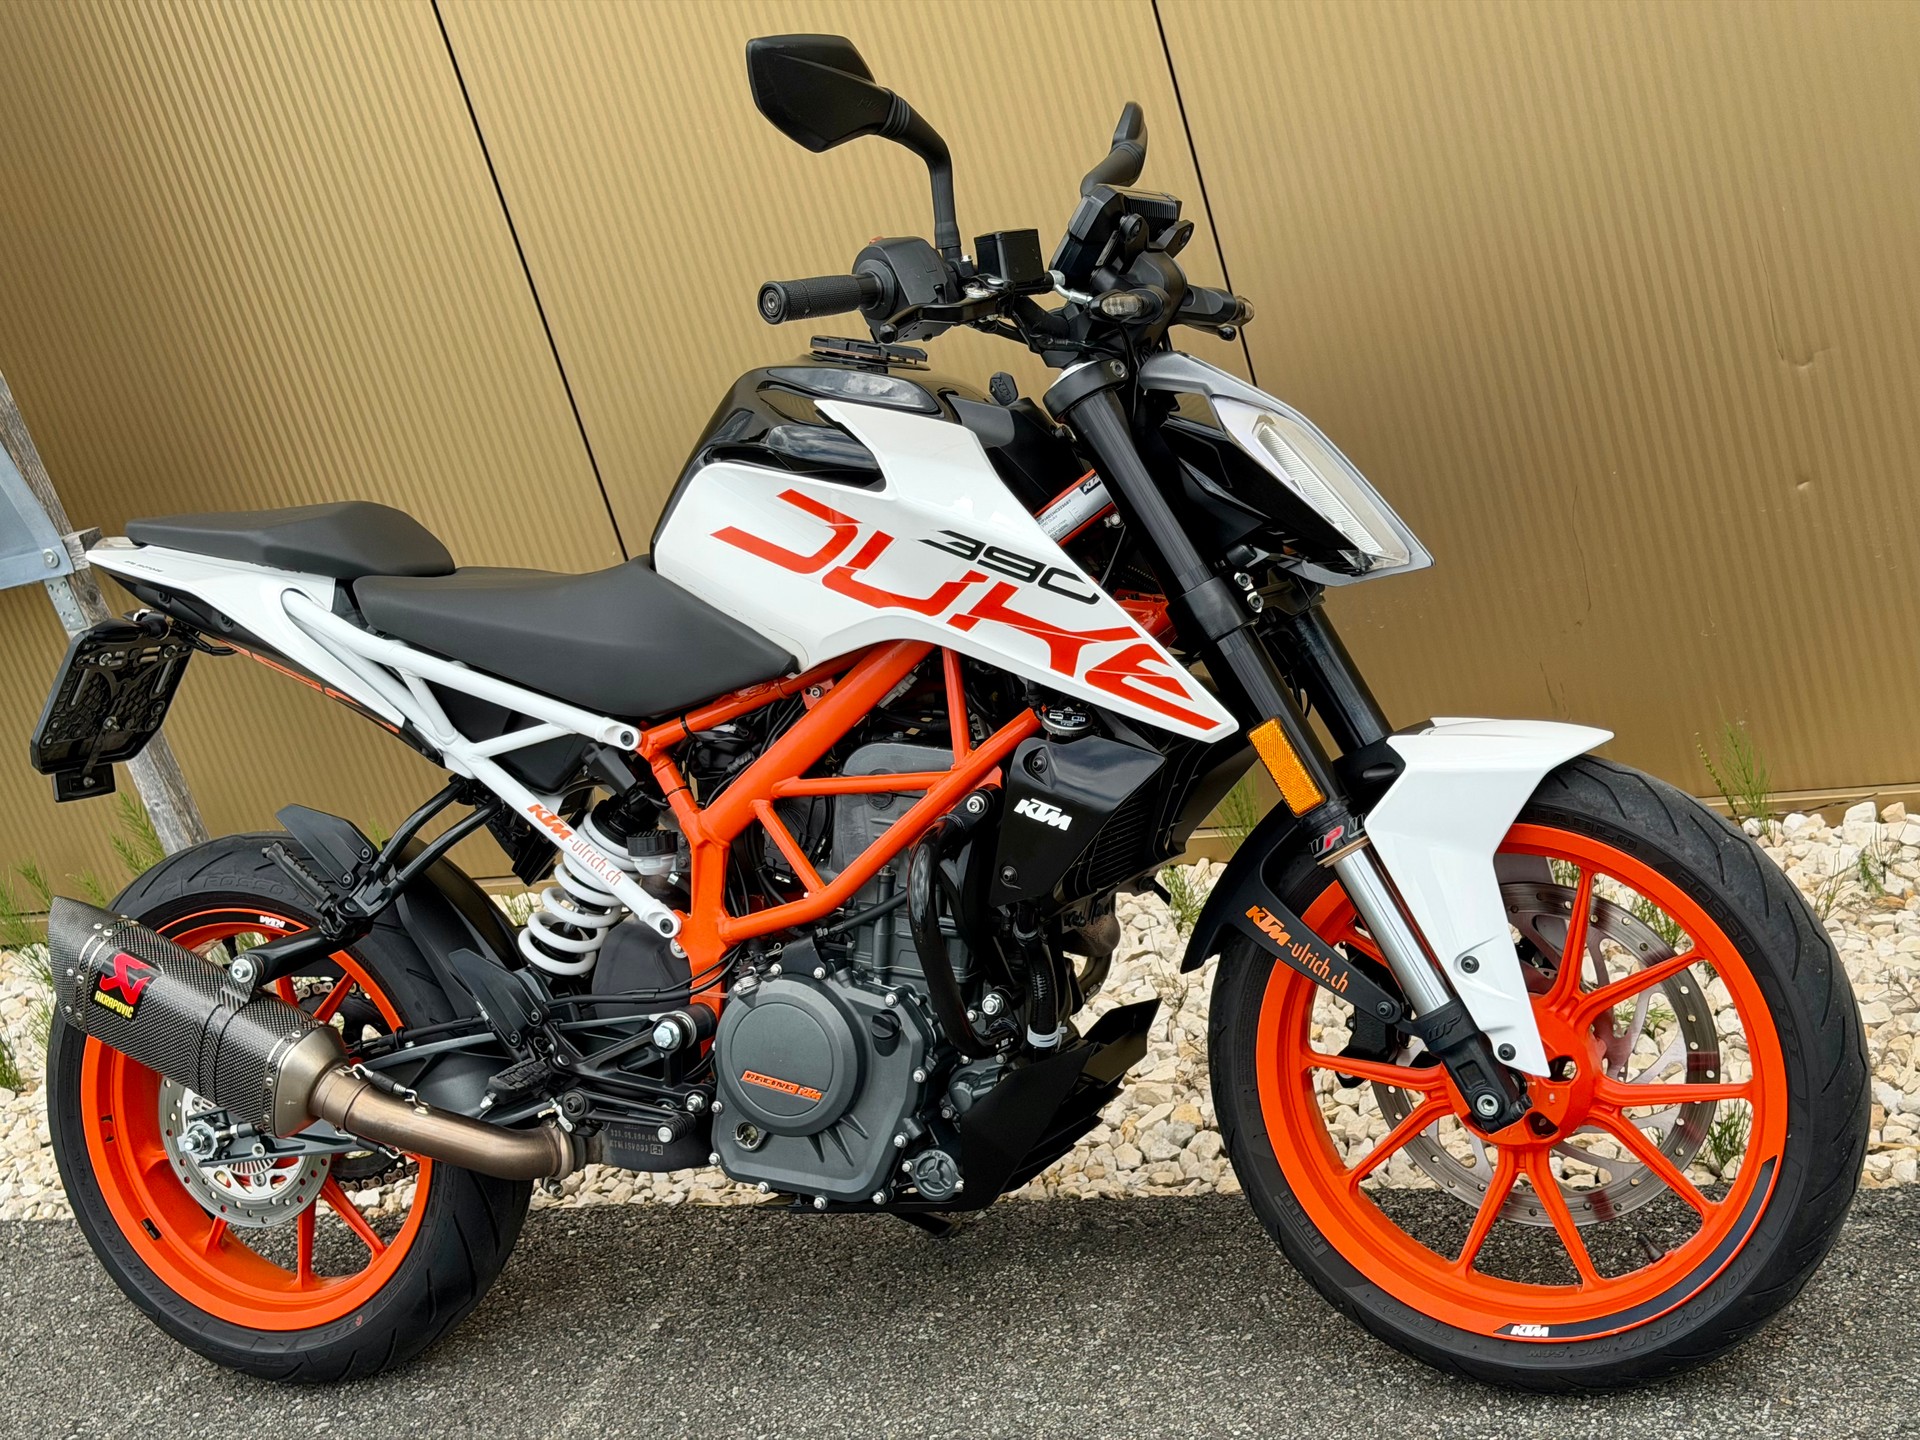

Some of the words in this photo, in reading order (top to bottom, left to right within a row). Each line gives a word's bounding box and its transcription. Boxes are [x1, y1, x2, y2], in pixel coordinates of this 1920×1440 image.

[918, 529, 1101, 605] 390
[709, 488, 1223, 731] DUKE
[527, 803, 623, 886] KTM-ulrich.ch
[1013, 798, 1073, 831] KTM
[259, 915, 286, 929] KTM
[1245, 905, 1349, 993] KTM-ulrich.ch
[1674, 869, 1758, 956] ROSSO
[1426, 1012, 1462, 1042] WP
[1271, 1188, 1330, 1260] PIRELLI
[1510, 1323, 1549, 1338] KTM
